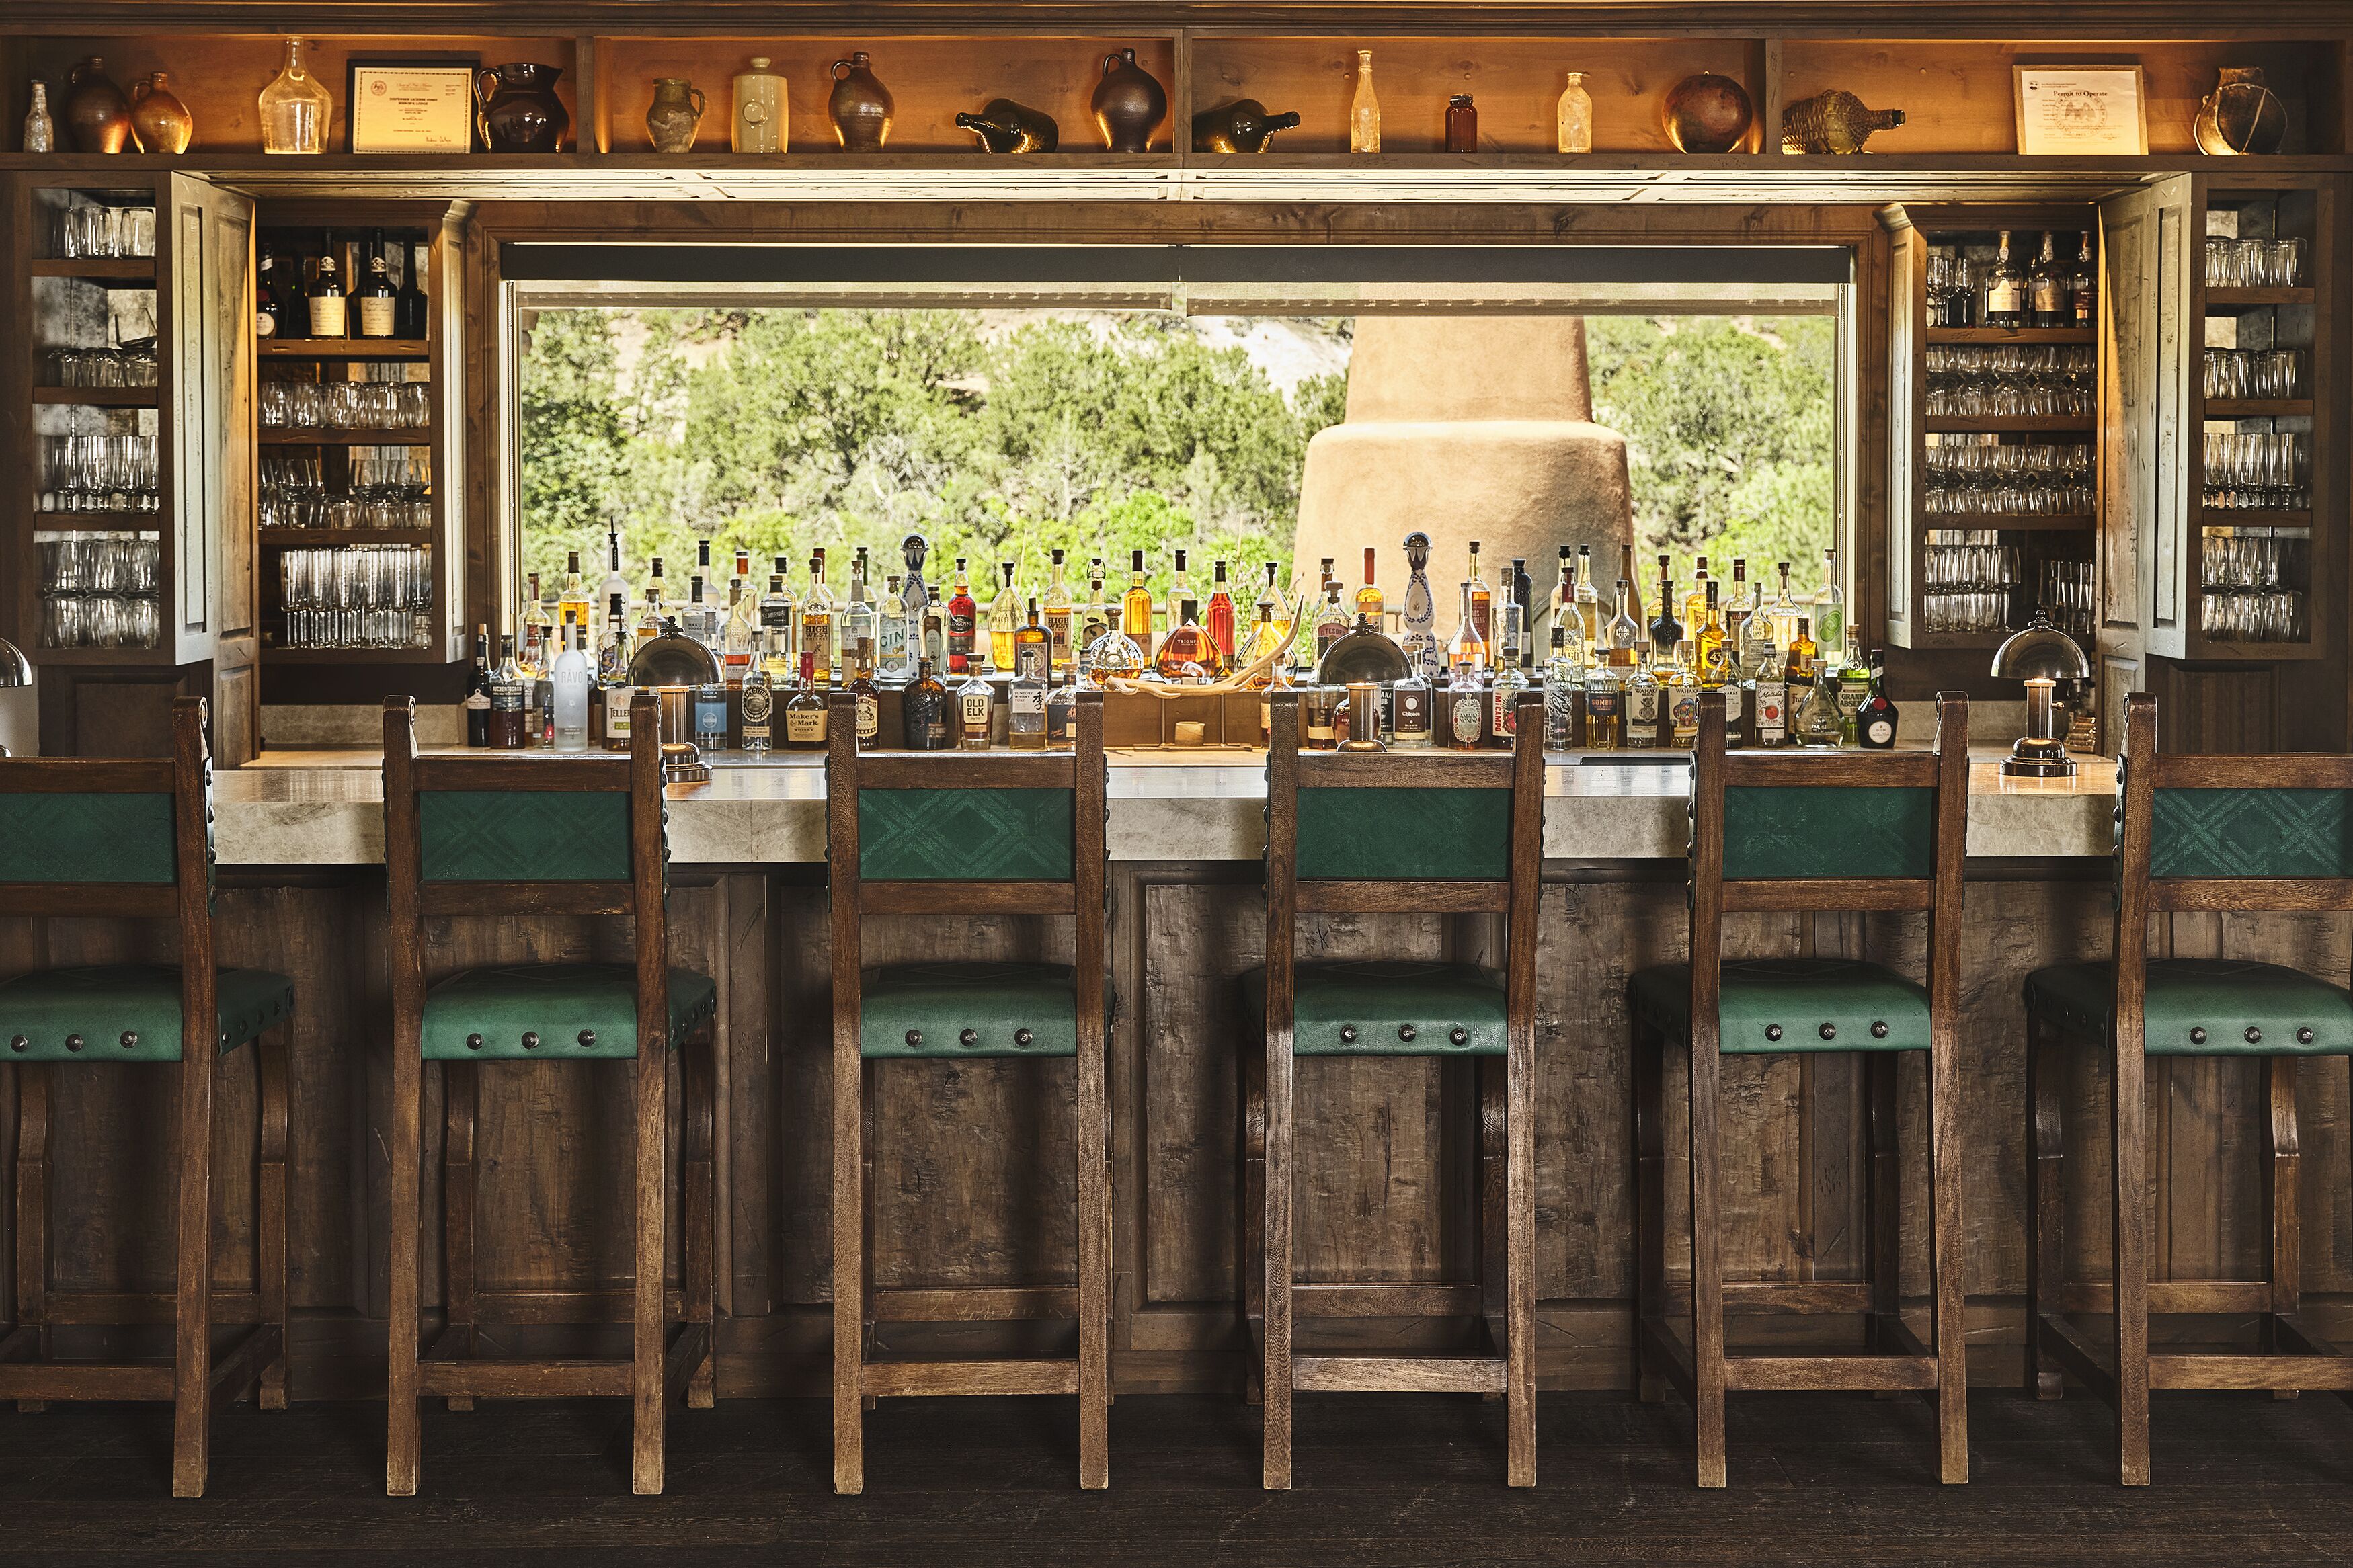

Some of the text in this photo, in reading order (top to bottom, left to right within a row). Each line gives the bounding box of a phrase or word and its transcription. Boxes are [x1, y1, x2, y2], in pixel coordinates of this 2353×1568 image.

[2083, 90, 2108, 98] Operate
[805, 625, 828, 633] HIGH
[879, 628, 904, 647] GIN
[1709, 650, 1722, 661] 43
[744, 688, 768, 700] EXPEDITION
[967, 699, 984, 708] OLD
[967, 708, 984, 716] ELK
